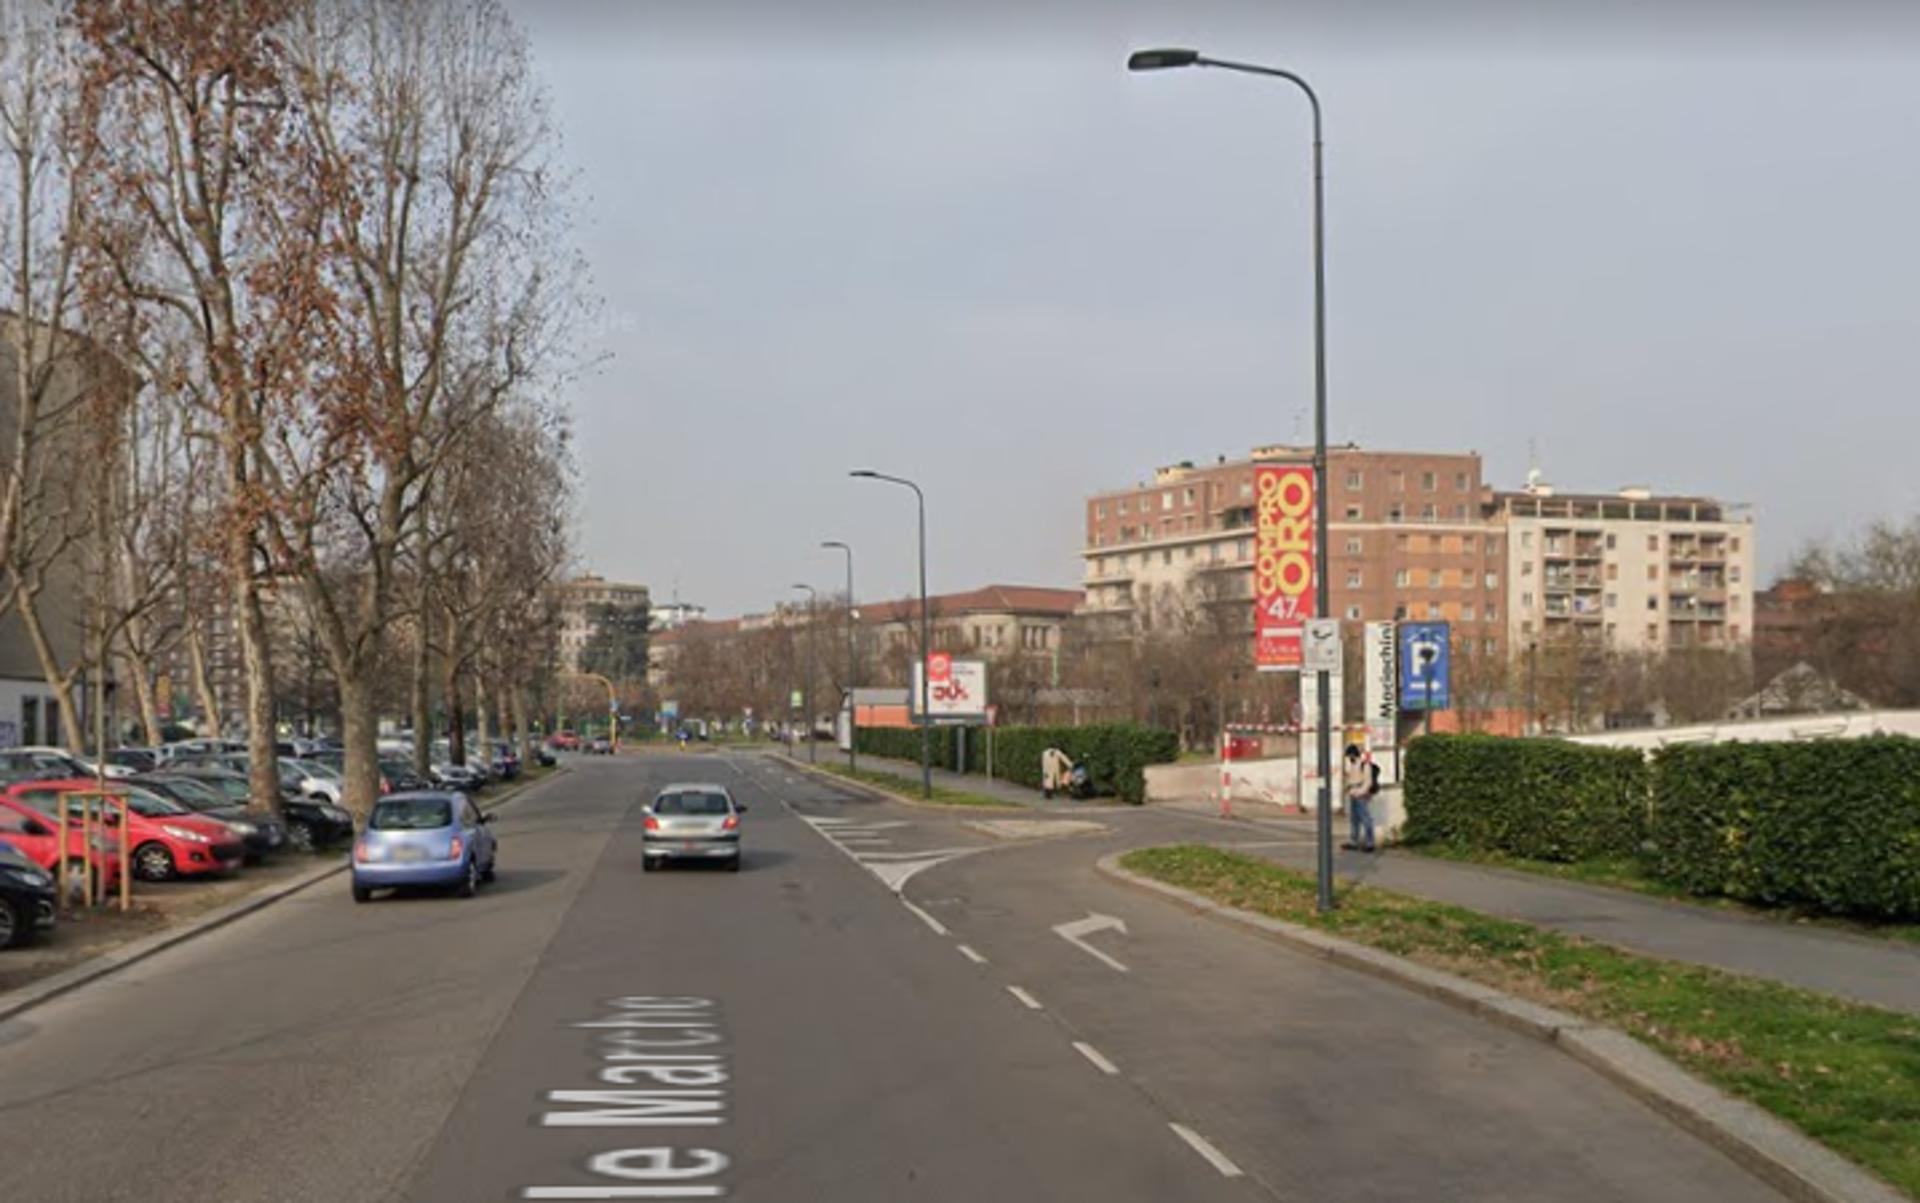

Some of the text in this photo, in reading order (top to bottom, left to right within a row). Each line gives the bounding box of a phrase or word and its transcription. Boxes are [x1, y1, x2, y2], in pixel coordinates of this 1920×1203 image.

[1259, 470, 1278, 598] COMPRO
[1279, 472, 1311, 597] ORO
[1268, 596, 1298, 619] 47
[1411, 641, 1440, 677] P
